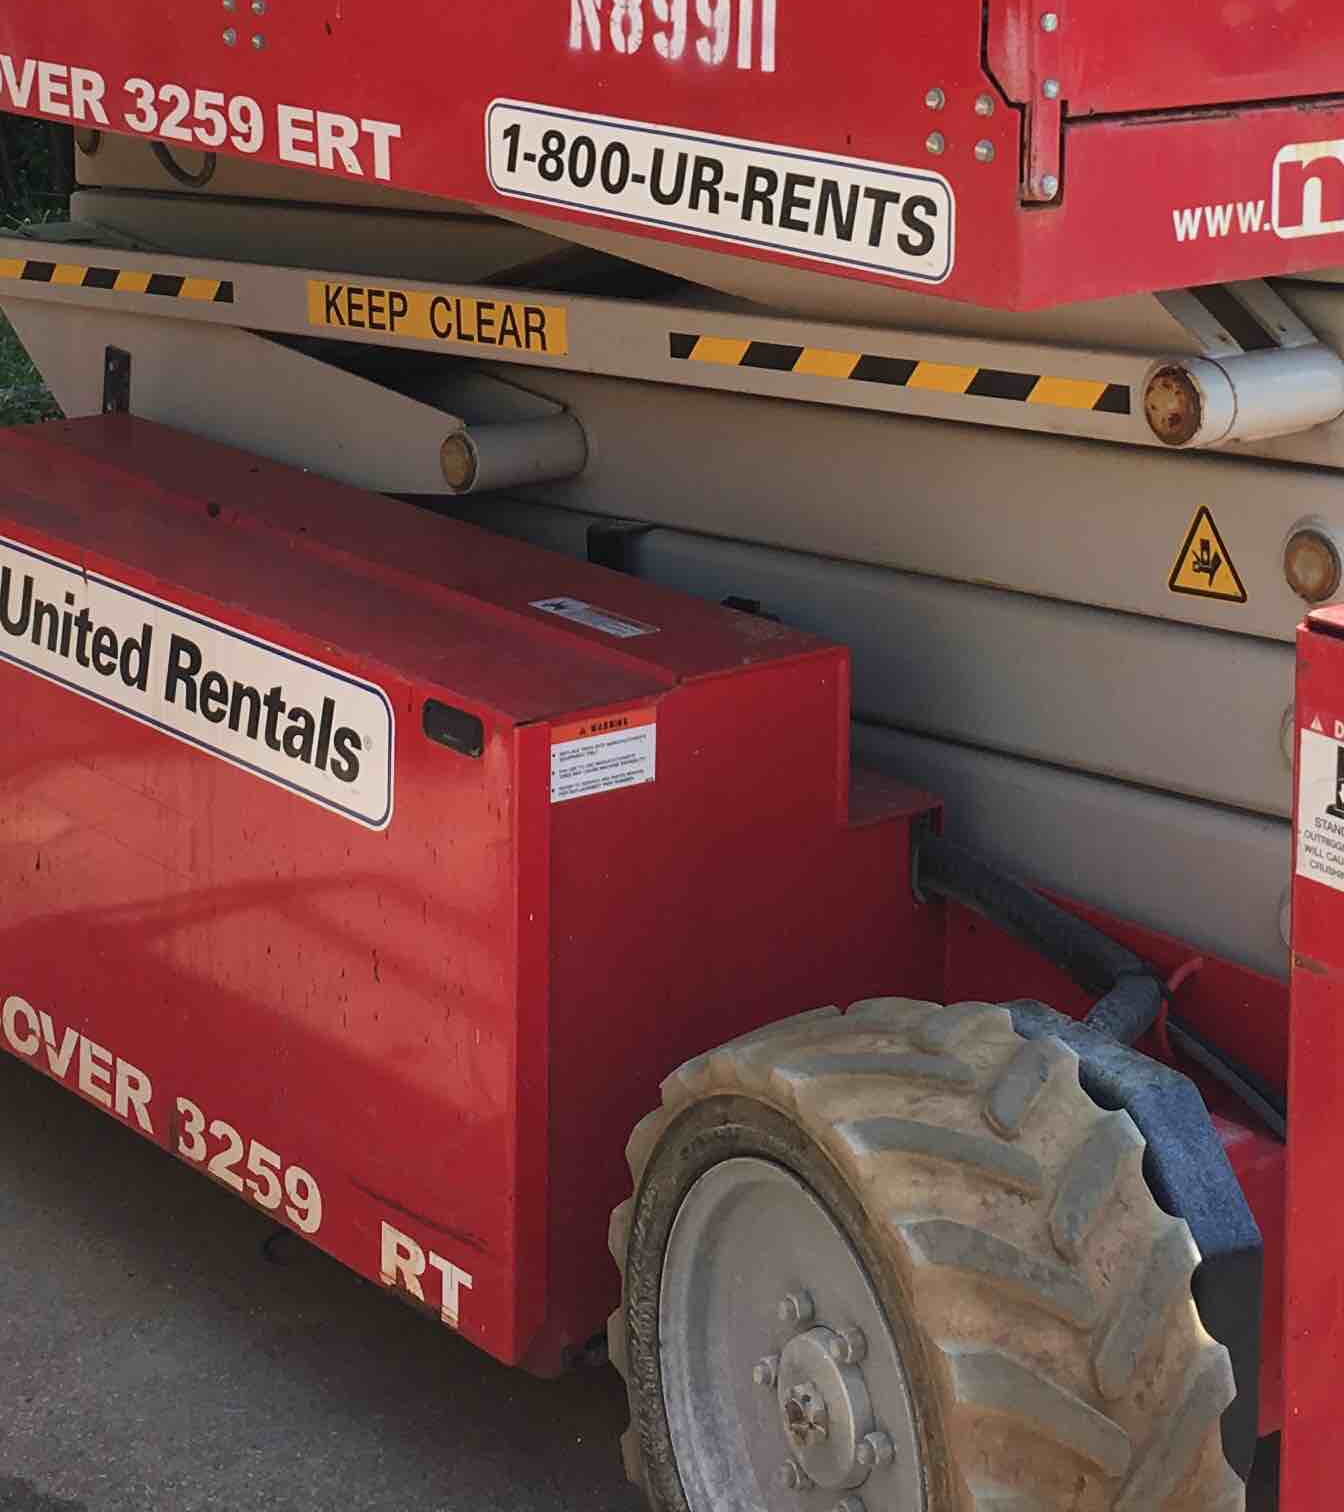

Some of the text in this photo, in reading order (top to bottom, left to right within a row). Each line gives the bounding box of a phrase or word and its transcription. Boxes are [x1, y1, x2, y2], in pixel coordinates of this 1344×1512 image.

[123, 78, 264, 153] 3259
[276, 104, 401, 182] ERT
[502, 122, 938, 257] 1-800-UR-RENTS
[324, 284, 547, 351] KEEP CLEAR
[0, 566, 362, 783] United Rentals
[1304, 845, 1324, 859] WILL
[175, 1096, 322, 1234] 3259
[378, 1220, 473, 1328] RT
